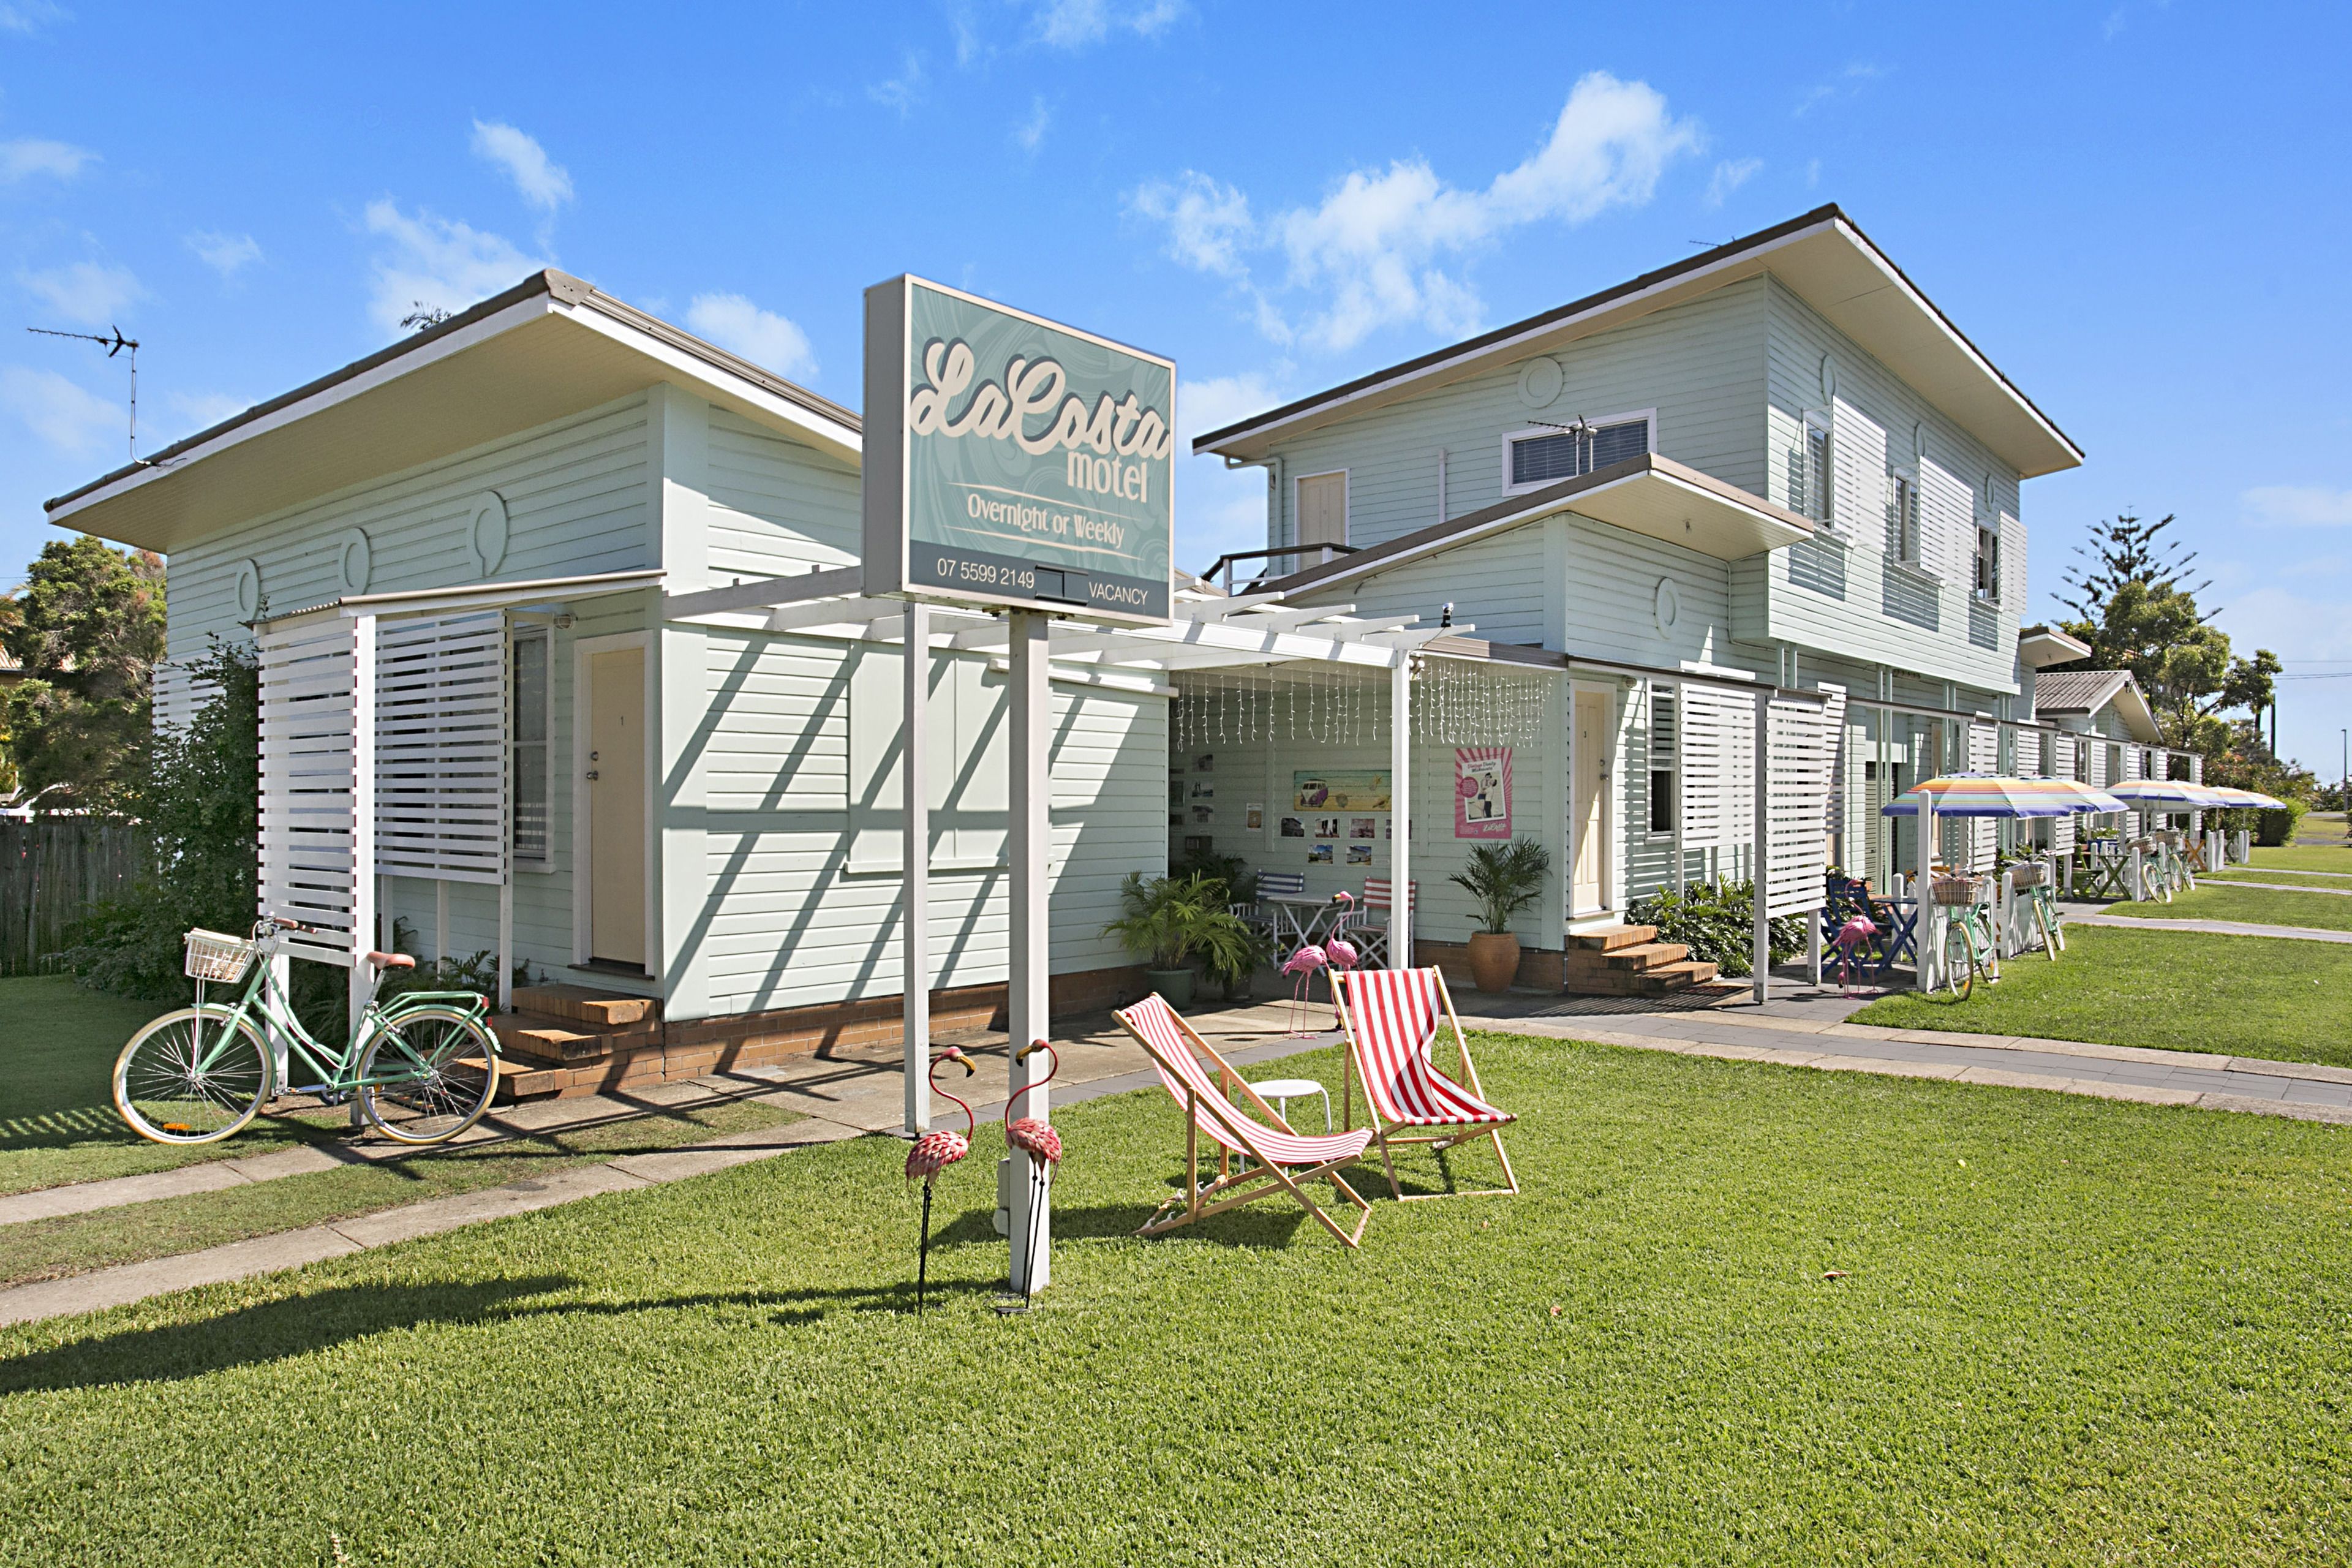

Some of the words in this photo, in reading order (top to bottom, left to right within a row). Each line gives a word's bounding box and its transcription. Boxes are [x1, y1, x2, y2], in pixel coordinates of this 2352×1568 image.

[1068, 451, 1147, 503] motel
[968, 493, 1049, 532] Overnight
[1053, 514, 1069, 535] or
[1074, 514, 1125, 549] Weekly
[937, 558, 956, 577] 07
[960, 562, 997, 583] 5599
[1000, 568, 1035, 589] 2149
[1088, 582, 1148, 605] VACANCY
